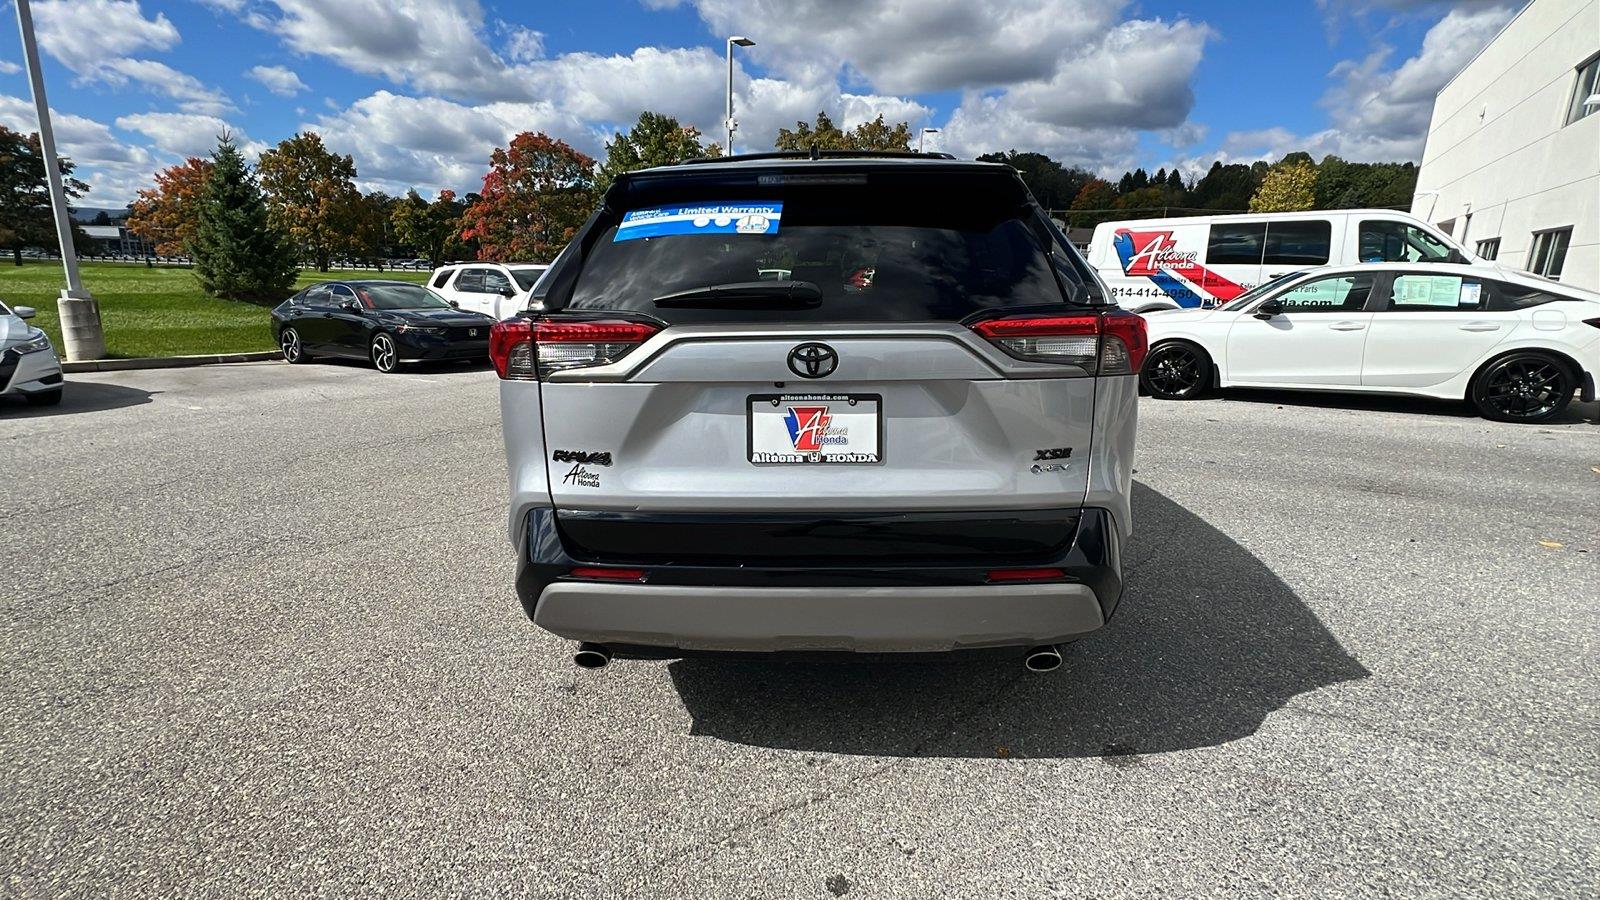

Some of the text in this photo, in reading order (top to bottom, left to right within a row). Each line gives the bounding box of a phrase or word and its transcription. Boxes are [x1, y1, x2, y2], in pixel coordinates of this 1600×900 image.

[678, 206, 774, 215] Limited Warranty
[1126, 234, 1197, 271] Altoona
[1154, 260, 1195, 269] Honda
[1111, 287, 1193, 298] 814-414-4950
[1300, 285, 1318, 293] Parts
[816, 435, 848, 445] Honda
[751, 452, 878, 463] Altoona HONDA
[562, 462, 600, 485] Altoona
[577, 479, 600, 488] Honda
